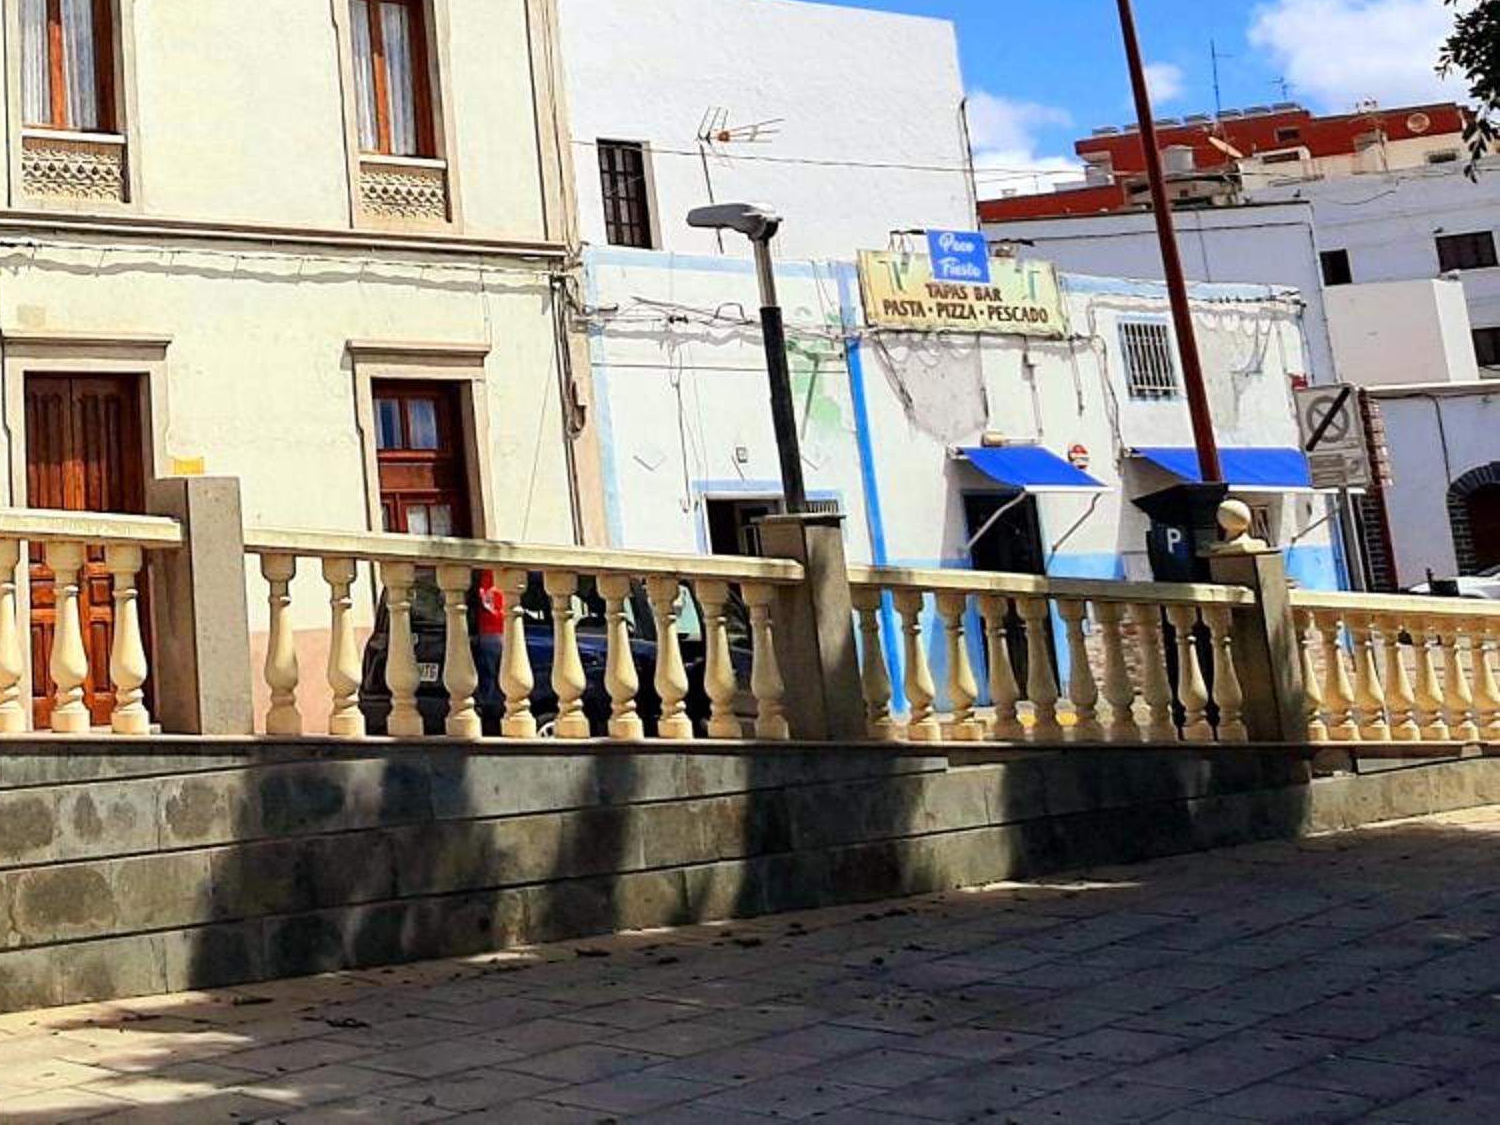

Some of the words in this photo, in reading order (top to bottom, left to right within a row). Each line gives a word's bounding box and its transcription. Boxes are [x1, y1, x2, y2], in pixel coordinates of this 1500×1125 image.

[925, 283, 969, 300] TAPAS
[974, 285, 1003, 302] BAR
[882, 299, 926, 317] PASTA
[935, 302, 978, 320] PIZZA
[987, 305, 1049, 323] PESCADO
[1166, 528, 1181, 554] P
